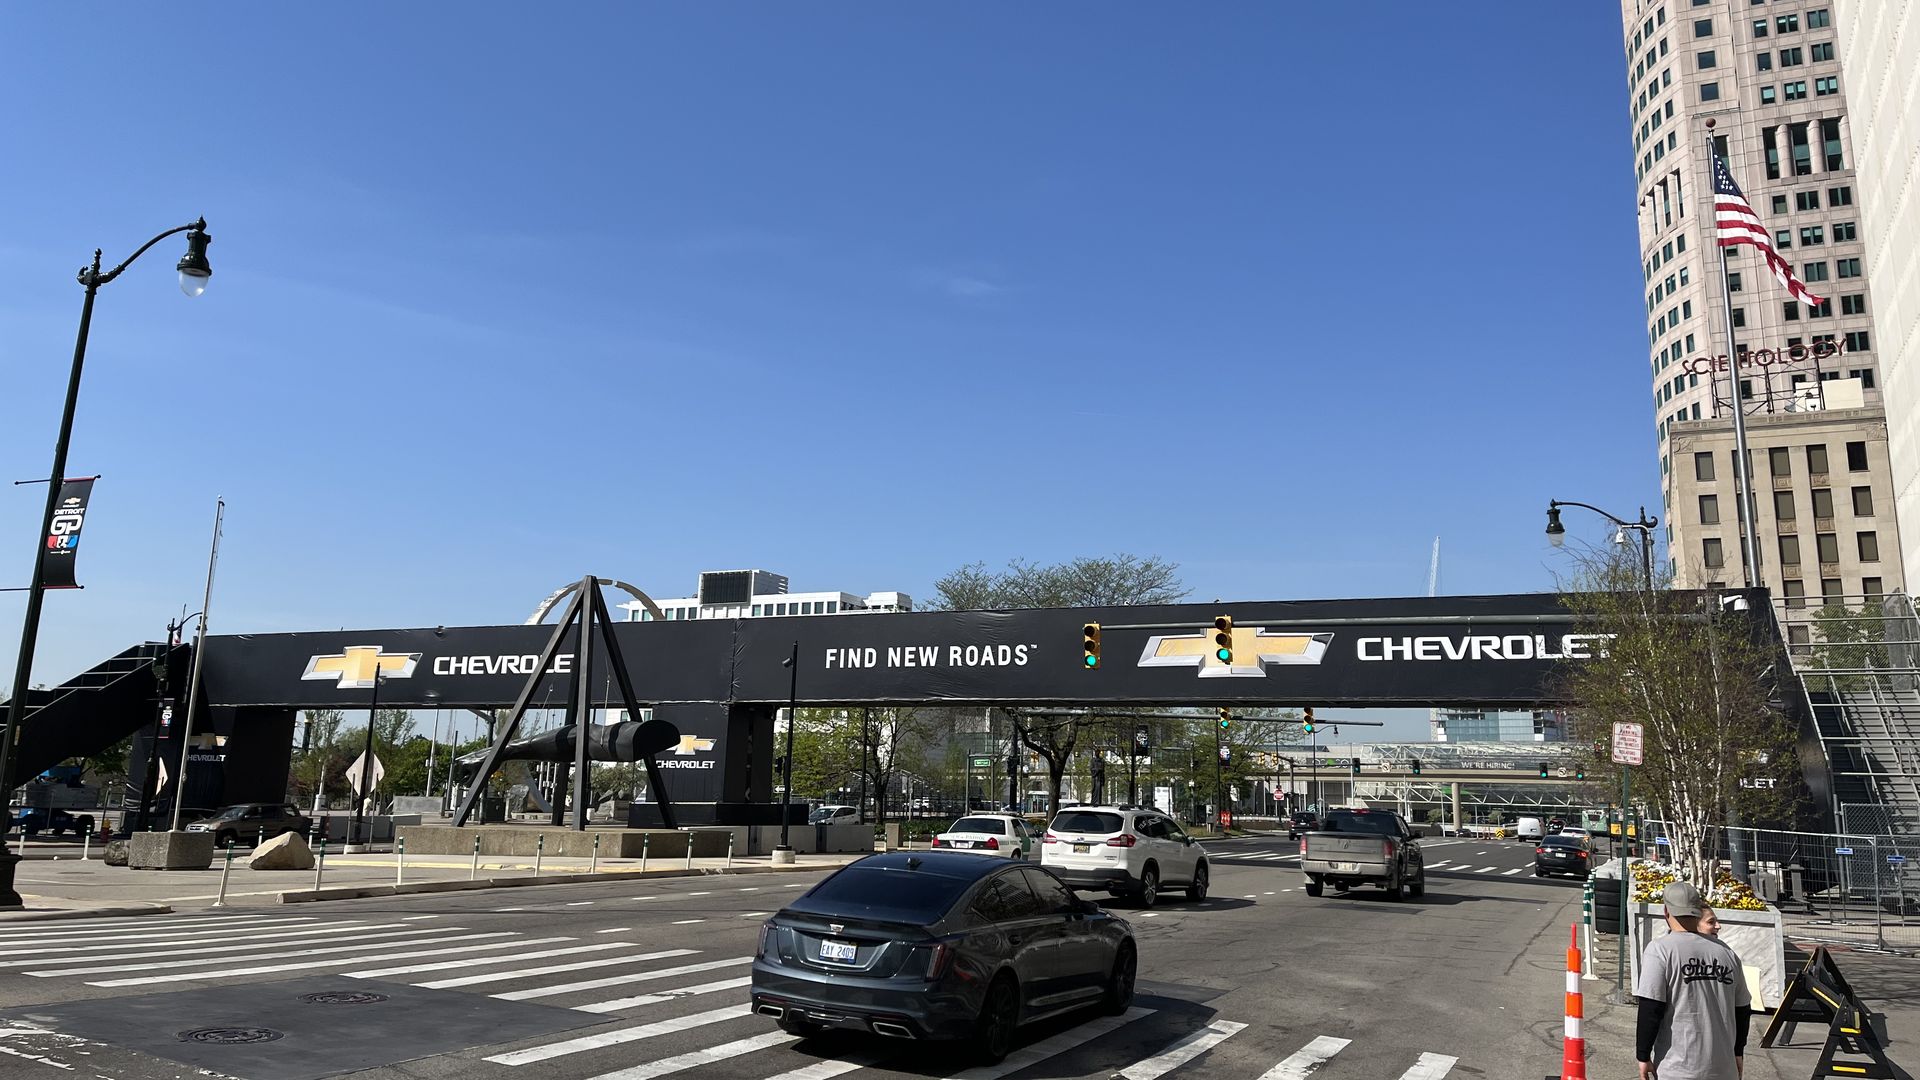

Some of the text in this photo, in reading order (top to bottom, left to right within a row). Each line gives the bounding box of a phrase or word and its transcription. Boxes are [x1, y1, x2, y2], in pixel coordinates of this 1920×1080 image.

[1681, 337, 1847, 377] SCIETOLOGY
[50, 515, 83, 536] GP
[433, 653, 575, 676] CHEVROE
[825, 648, 877, 669] FIND
[887, 646, 939, 668] NEW
[187, 754, 226, 762] HEVROLET
[1681, 957, 1734, 985] Sticky
